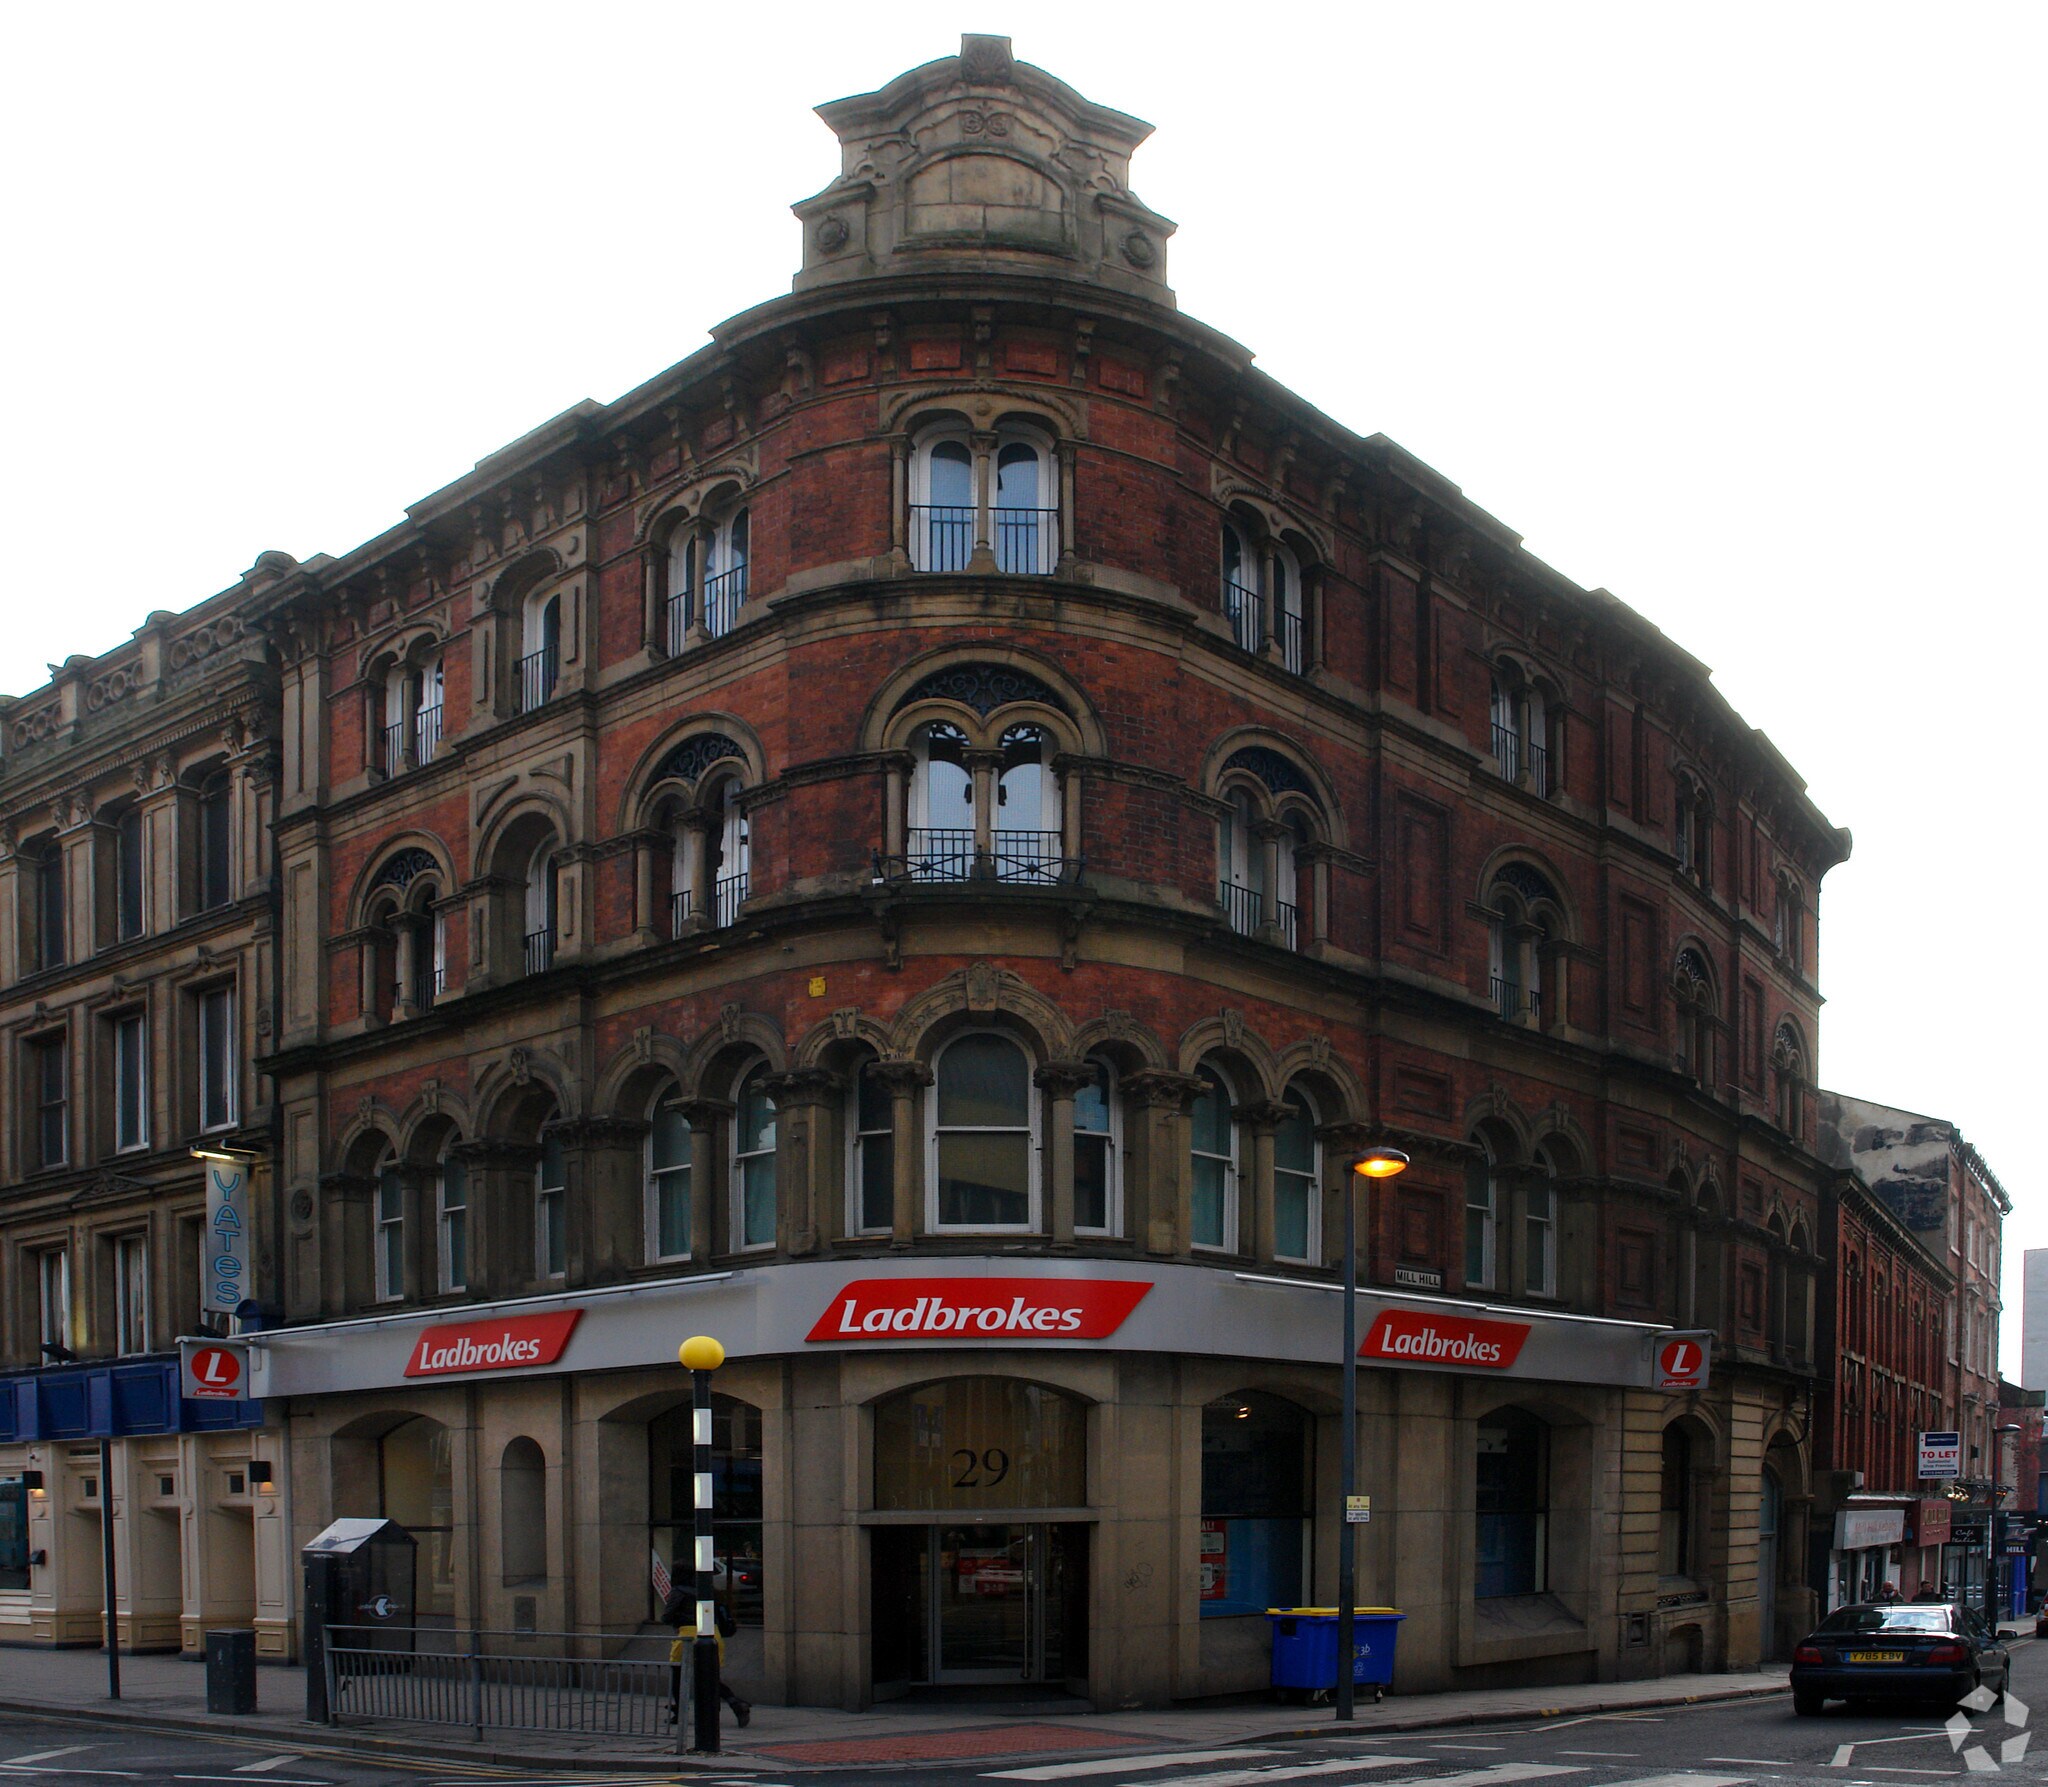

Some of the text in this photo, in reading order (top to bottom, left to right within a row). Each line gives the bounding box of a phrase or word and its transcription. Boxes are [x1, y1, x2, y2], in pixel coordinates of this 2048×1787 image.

[1397, 1270, 1439, 1286] MILL HILL
[838, 1297, 1083, 1333] Ladbrokes
[420, 1333, 540, 1370] Ladbrokes
[1381, 1324, 1501, 1362] Ladbrokes
[1671, 1344, 1690, 1373] L
[204, 1352, 227, 1382] L
[952, 1448, 1009, 1488] 29
[1921, 1450, 1957, 1459] TO LET
